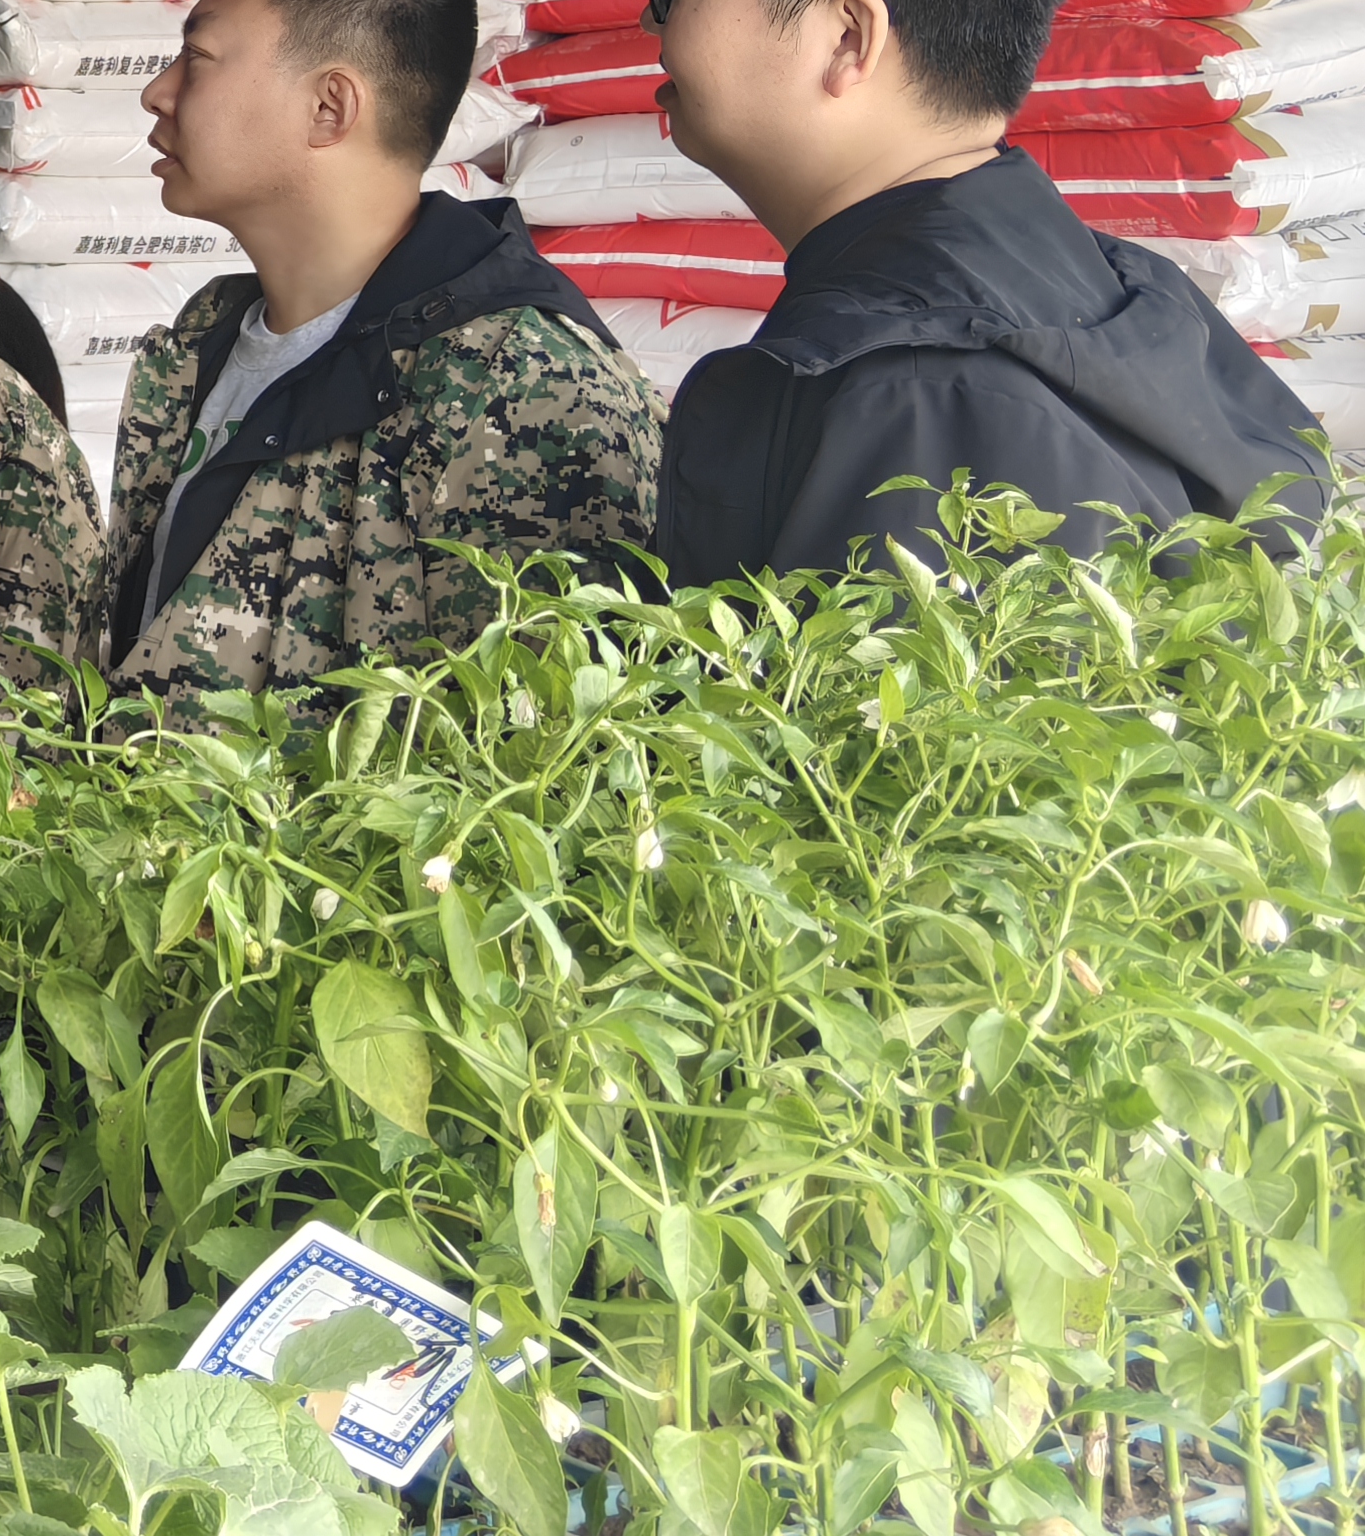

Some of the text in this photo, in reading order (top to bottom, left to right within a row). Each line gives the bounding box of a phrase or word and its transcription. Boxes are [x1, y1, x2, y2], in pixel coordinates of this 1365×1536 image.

[74, 55, 180, 77] 嘉施利复合肥料
